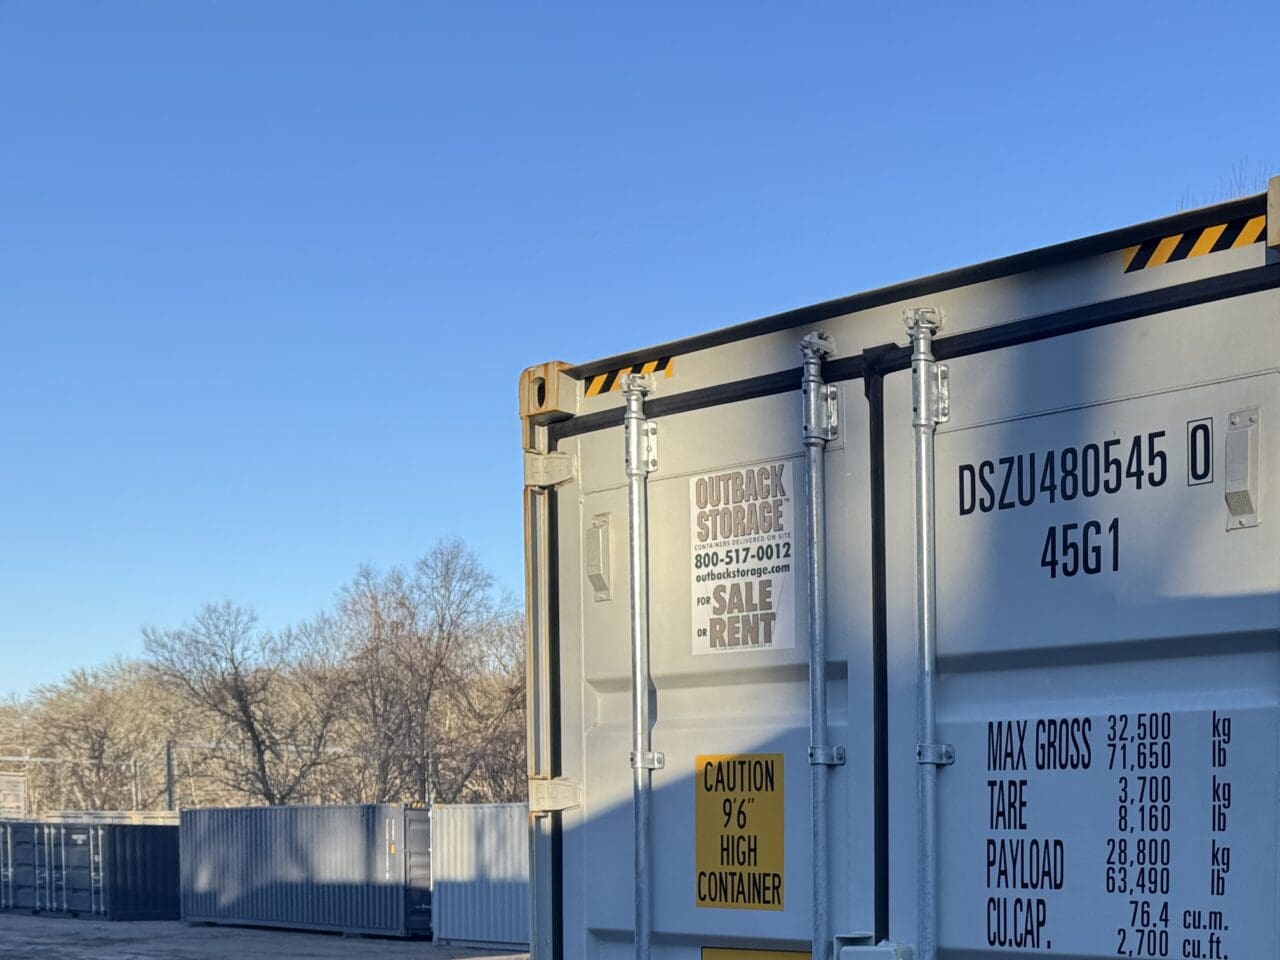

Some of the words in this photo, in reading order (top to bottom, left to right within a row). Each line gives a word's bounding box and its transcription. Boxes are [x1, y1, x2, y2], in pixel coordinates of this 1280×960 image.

[695, 464, 786, 509] OUTBACK
[958, 430, 1168, 516] DSZU480545
[1190, 423, 1211, 481] 0
[697, 498, 784, 543] STORAGE
[694, 541, 731, 551] CONTAINERS
[732, 536, 765, 546] DELIVERED
[767, 533, 776, 541] ON
[778, 532, 792, 540] SITE
[694, 541, 791, 570] 800-517-0012
[1040, 517, 1119, 579] 45G1
[695, 563, 790, 583] outbackstorage.com
[696, 596, 711, 606] FOR
[712, 579, 773, 617] SALE
[697, 628, 708, 638] OR
[709, 612, 776, 648] RENT
[987, 720, 1028, 771] MAX
[1035, 717, 1092, 771] GROSS
[1107, 712, 1171, 743] 32,500
[1212, 710, 1231, 744] kg
[1107, 742, 1171, 772] 71,650
[1212, 740, 1226, 768] lb
[703, 760, 775, 793] CAUTION
[987, 780, 1028, 830] TARE
[1118, 776, 1171, 805] 3,700
[1212, 775, 1231, 809] kg
[1118, 805, 1171, 834] 8,160
[1212, 804, 1226, 832] lb
[720, 834, 758, 867] HIGH
[986, 838, 1064, 890] PAYLOAD
[1106, 838, 1170, 868] 28,800
[1211, 839, 1230, 874] kg
[697, 871, 782, 905] CONTAINER
[1106, 867, 1170, 896] 63,490
[1211, 868, 1225, 896] lb
[987, 897, 1052, 949] CU.CAP.
[1129, 901, 1169, 928] 76.4
[1183, 910, 1229, 931] cu.m.
[1117, 928, 1169, 957] 2,700
[1182, 933, 1229, 960] cu.ft.
